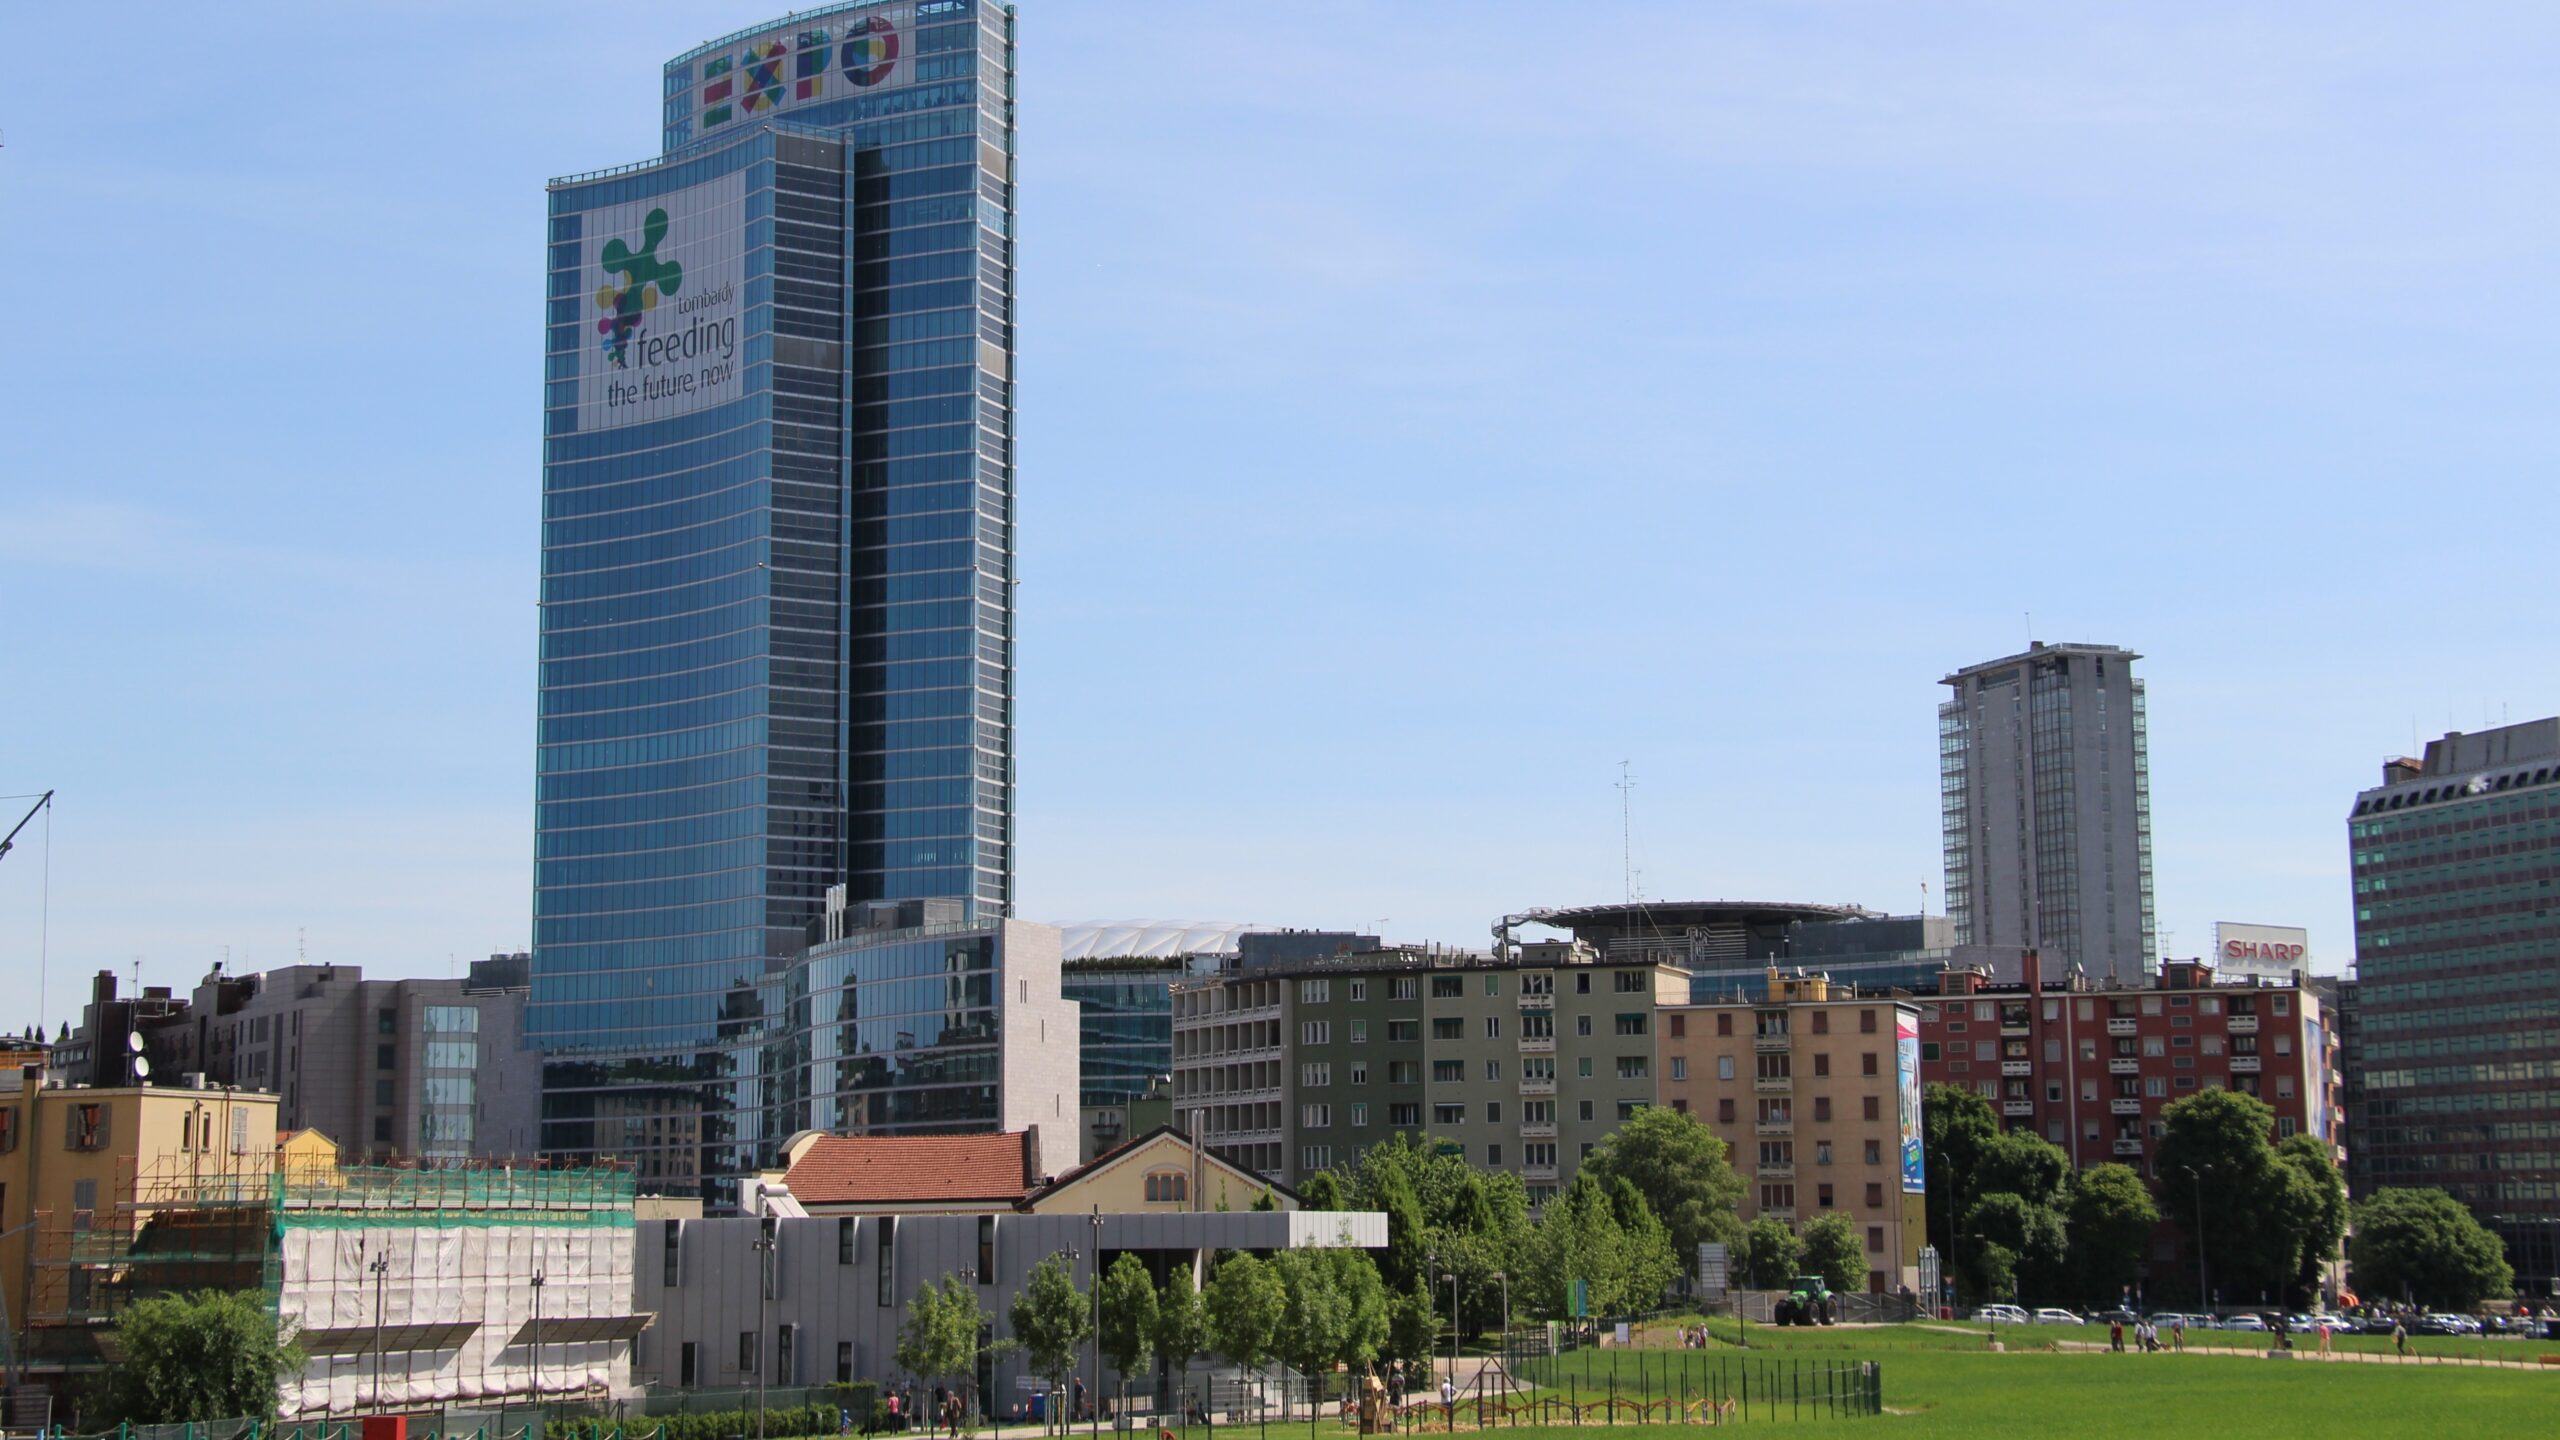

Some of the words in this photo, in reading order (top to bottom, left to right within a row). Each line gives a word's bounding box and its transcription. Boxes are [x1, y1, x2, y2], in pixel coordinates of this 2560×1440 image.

[704, 16, 898, 129] EXPO
[679, 281, 734, 314] Lombardy
[638, 317, 734, 369] feeding
[608, 380, 637, 407] the
[643, 375, 697, 401] future,
[701, 361, 734, 388] now
[2226, 940, 2304, 960] SHARP
